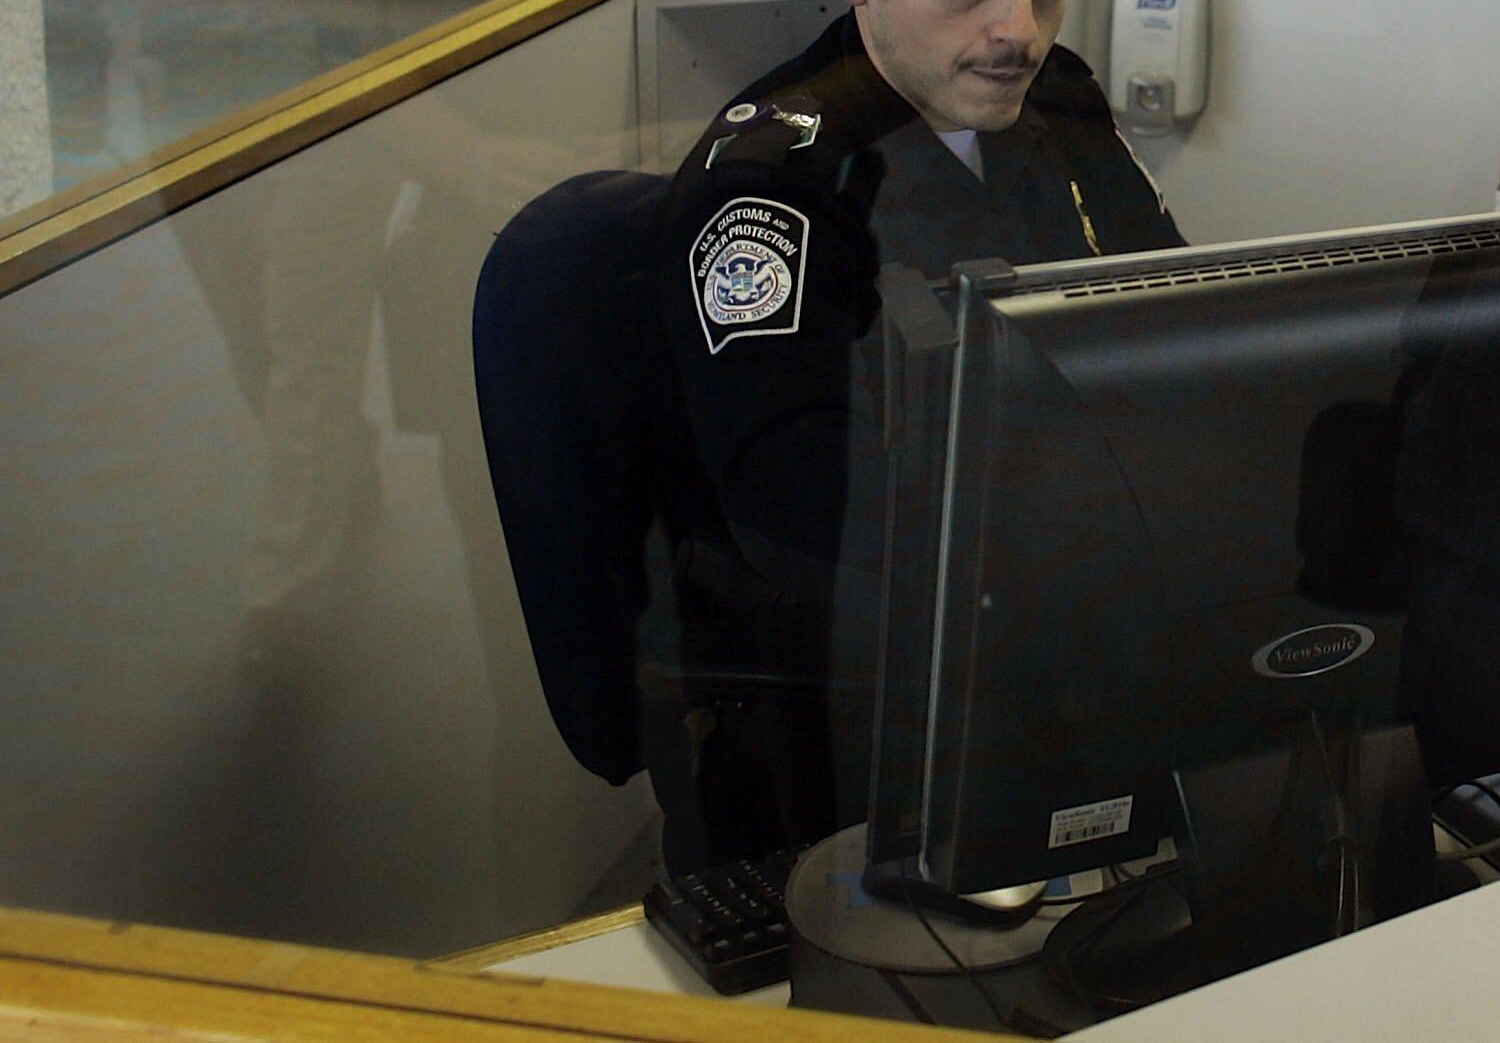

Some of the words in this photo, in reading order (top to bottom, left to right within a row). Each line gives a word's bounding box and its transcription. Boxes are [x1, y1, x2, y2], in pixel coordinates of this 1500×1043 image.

[718, 208, 771, 232] CUSTOMS
[772, 218, 790, 231] AND
[697, 234, 729, 278] BORDER
[729, 224, 798, 257] PROTECTION
[1275, 636, 1357, 663] ViewSonic
